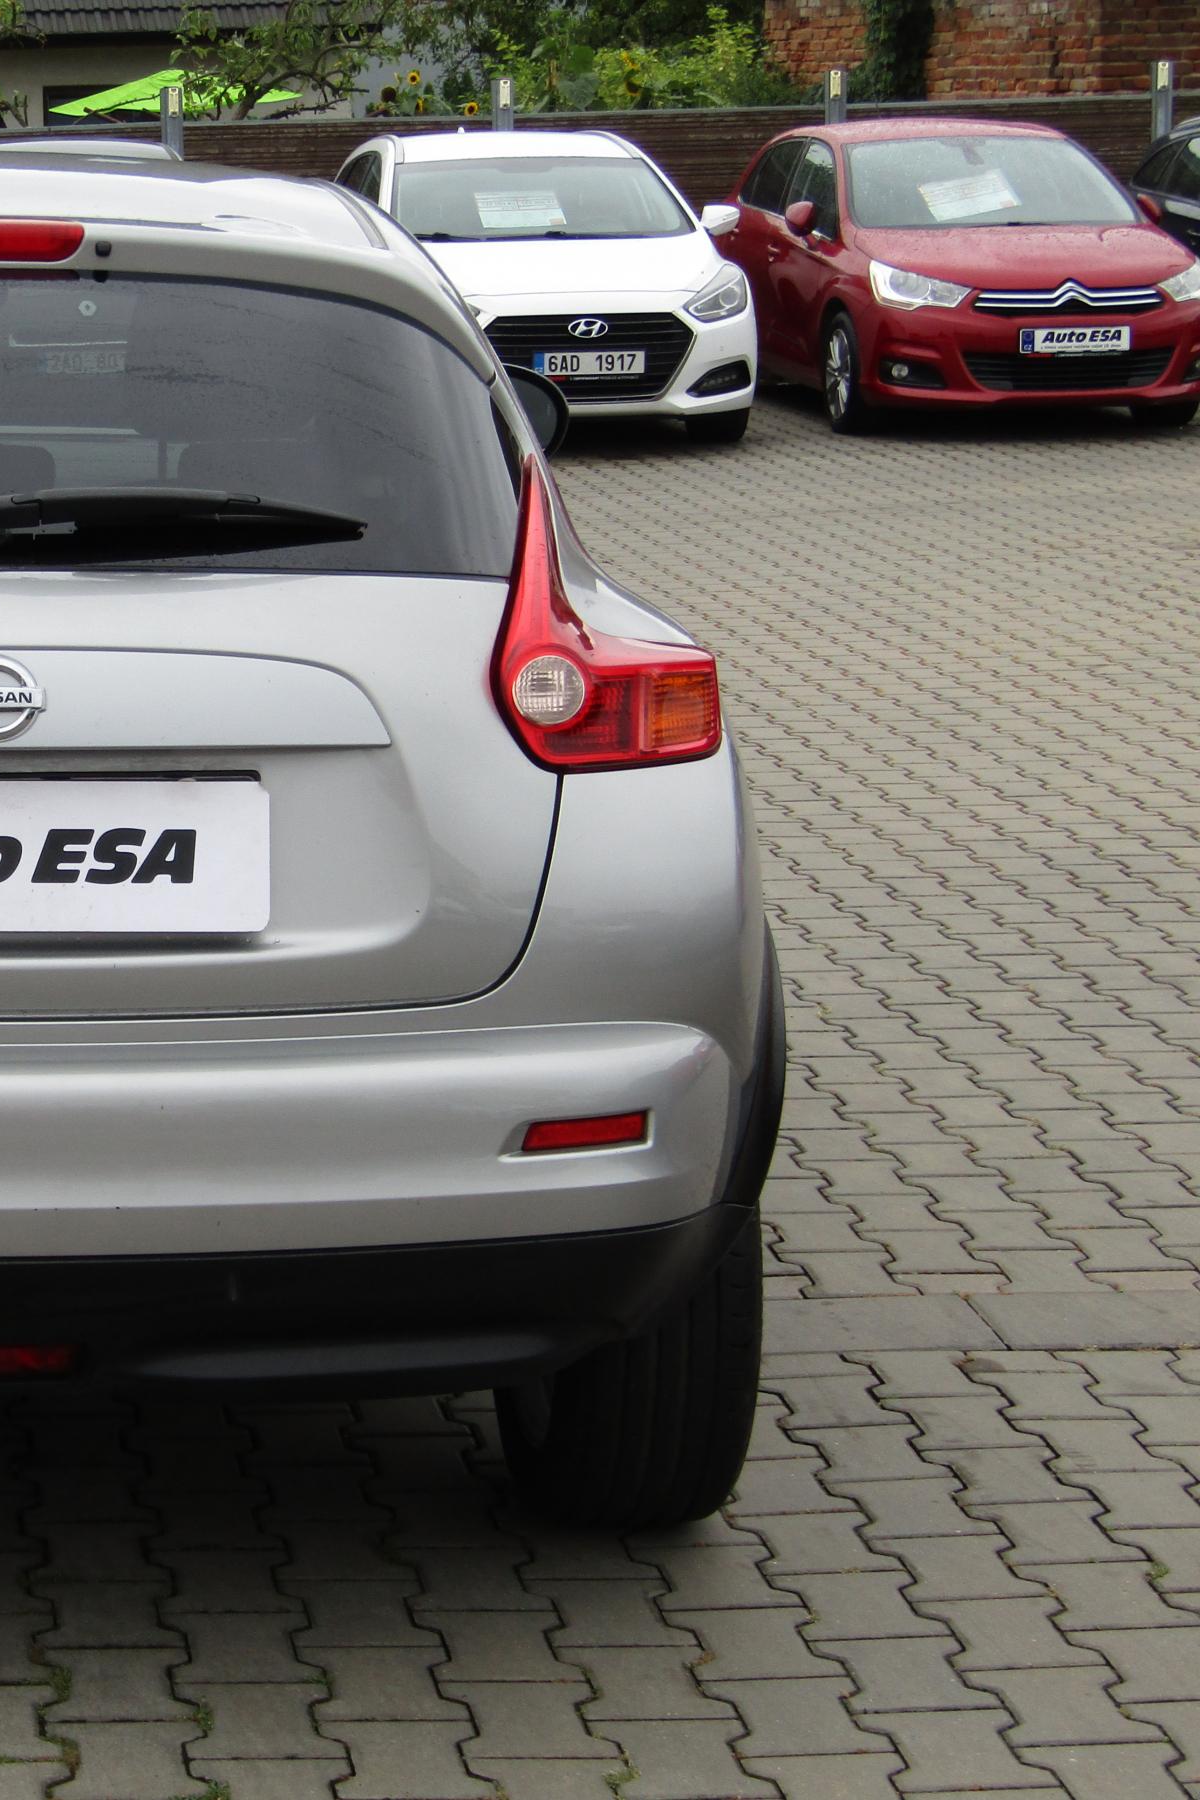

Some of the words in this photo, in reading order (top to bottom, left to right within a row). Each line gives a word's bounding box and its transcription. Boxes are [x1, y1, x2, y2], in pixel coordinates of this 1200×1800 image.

[1042, 331, 1087, 343] Auto
[1089, 329, 1122, 342] ESA
[548, 355, 580, 372] 6AD
[595, 353, 637, 371] 1917
[31, 827, 197, 885] ESA
